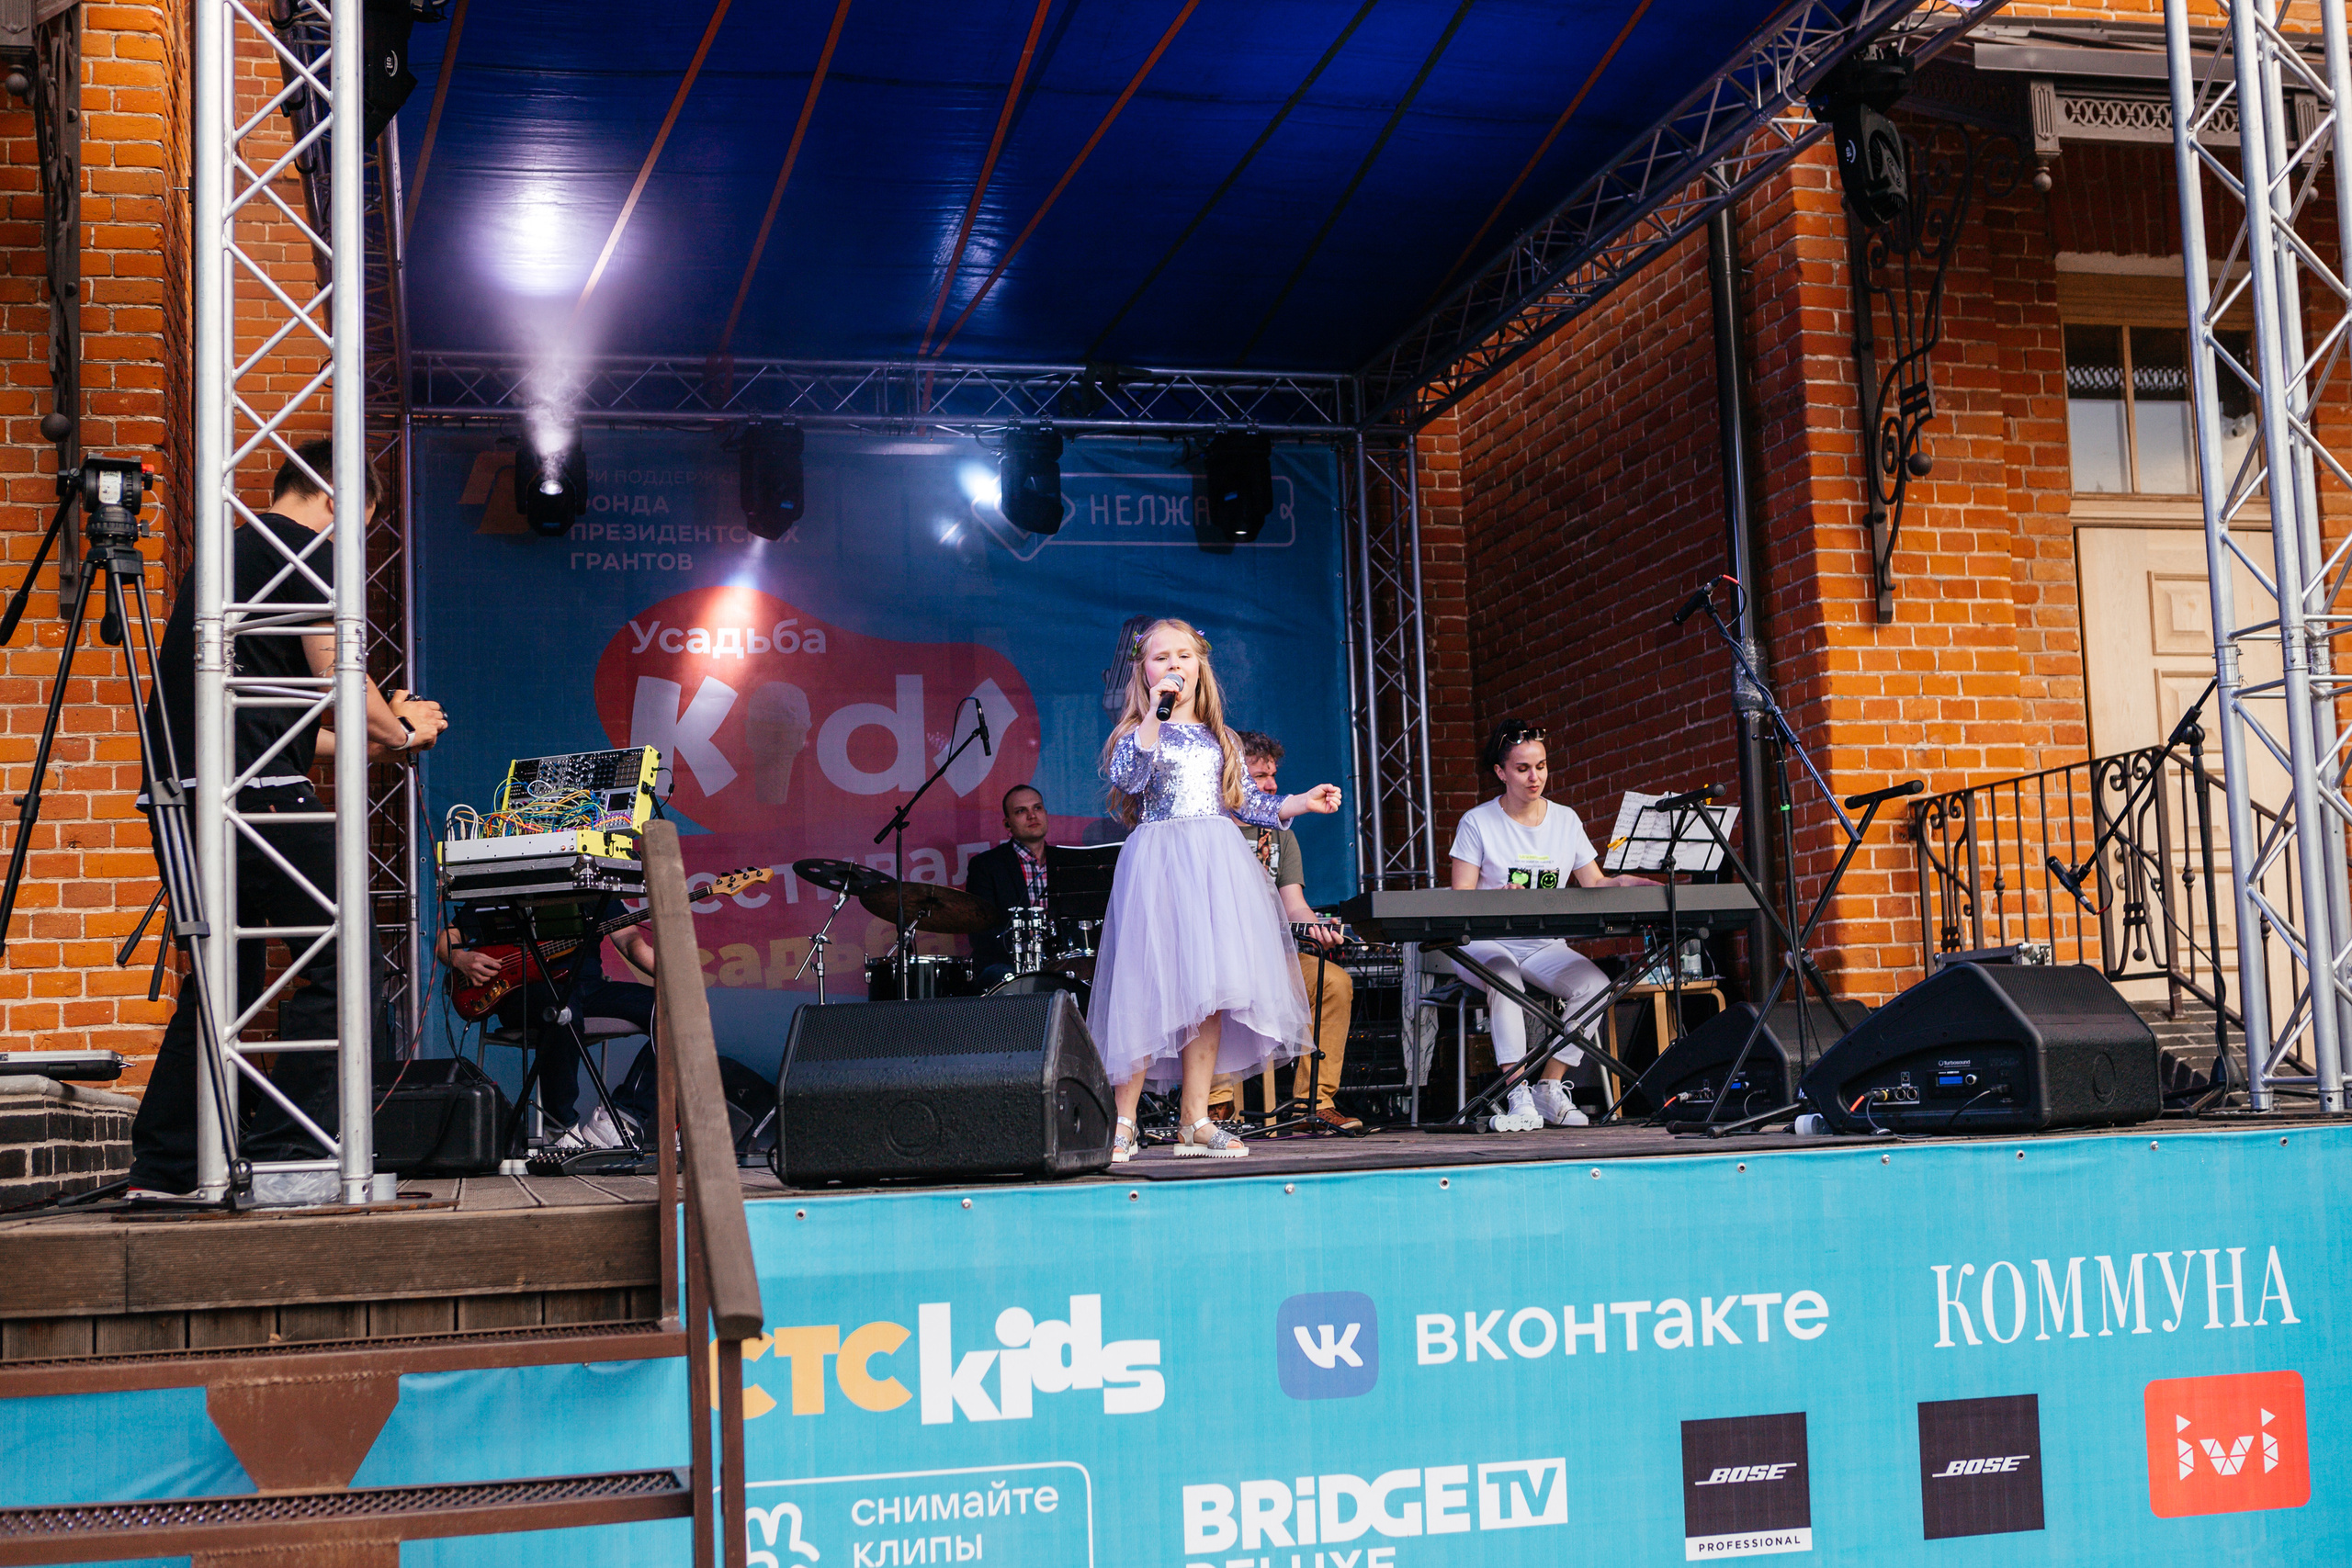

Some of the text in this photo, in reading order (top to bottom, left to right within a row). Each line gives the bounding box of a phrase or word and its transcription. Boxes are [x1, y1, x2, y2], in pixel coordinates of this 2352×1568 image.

[585, 494, 670, 517] ОНДА
[571, 552, 694, 571] ГРАНТОВ
[630, 618, 827, 659] Усадьба
[1930, 1246, 2301, 1348] КОММУНА
[918, 1293, 1166, 1425] kids
[1695, 1462, 1797, 1486] BOSE
[1932, 1455, 2030, 1478] BOSE
[851, 1481, 1059, 1526] снимайте
[1487, 1466, 1558, 1520] TV
[853, 1532, 983, 1568] клипы
[1698, 1534, 1802, 1552] PROFESSIONAL
